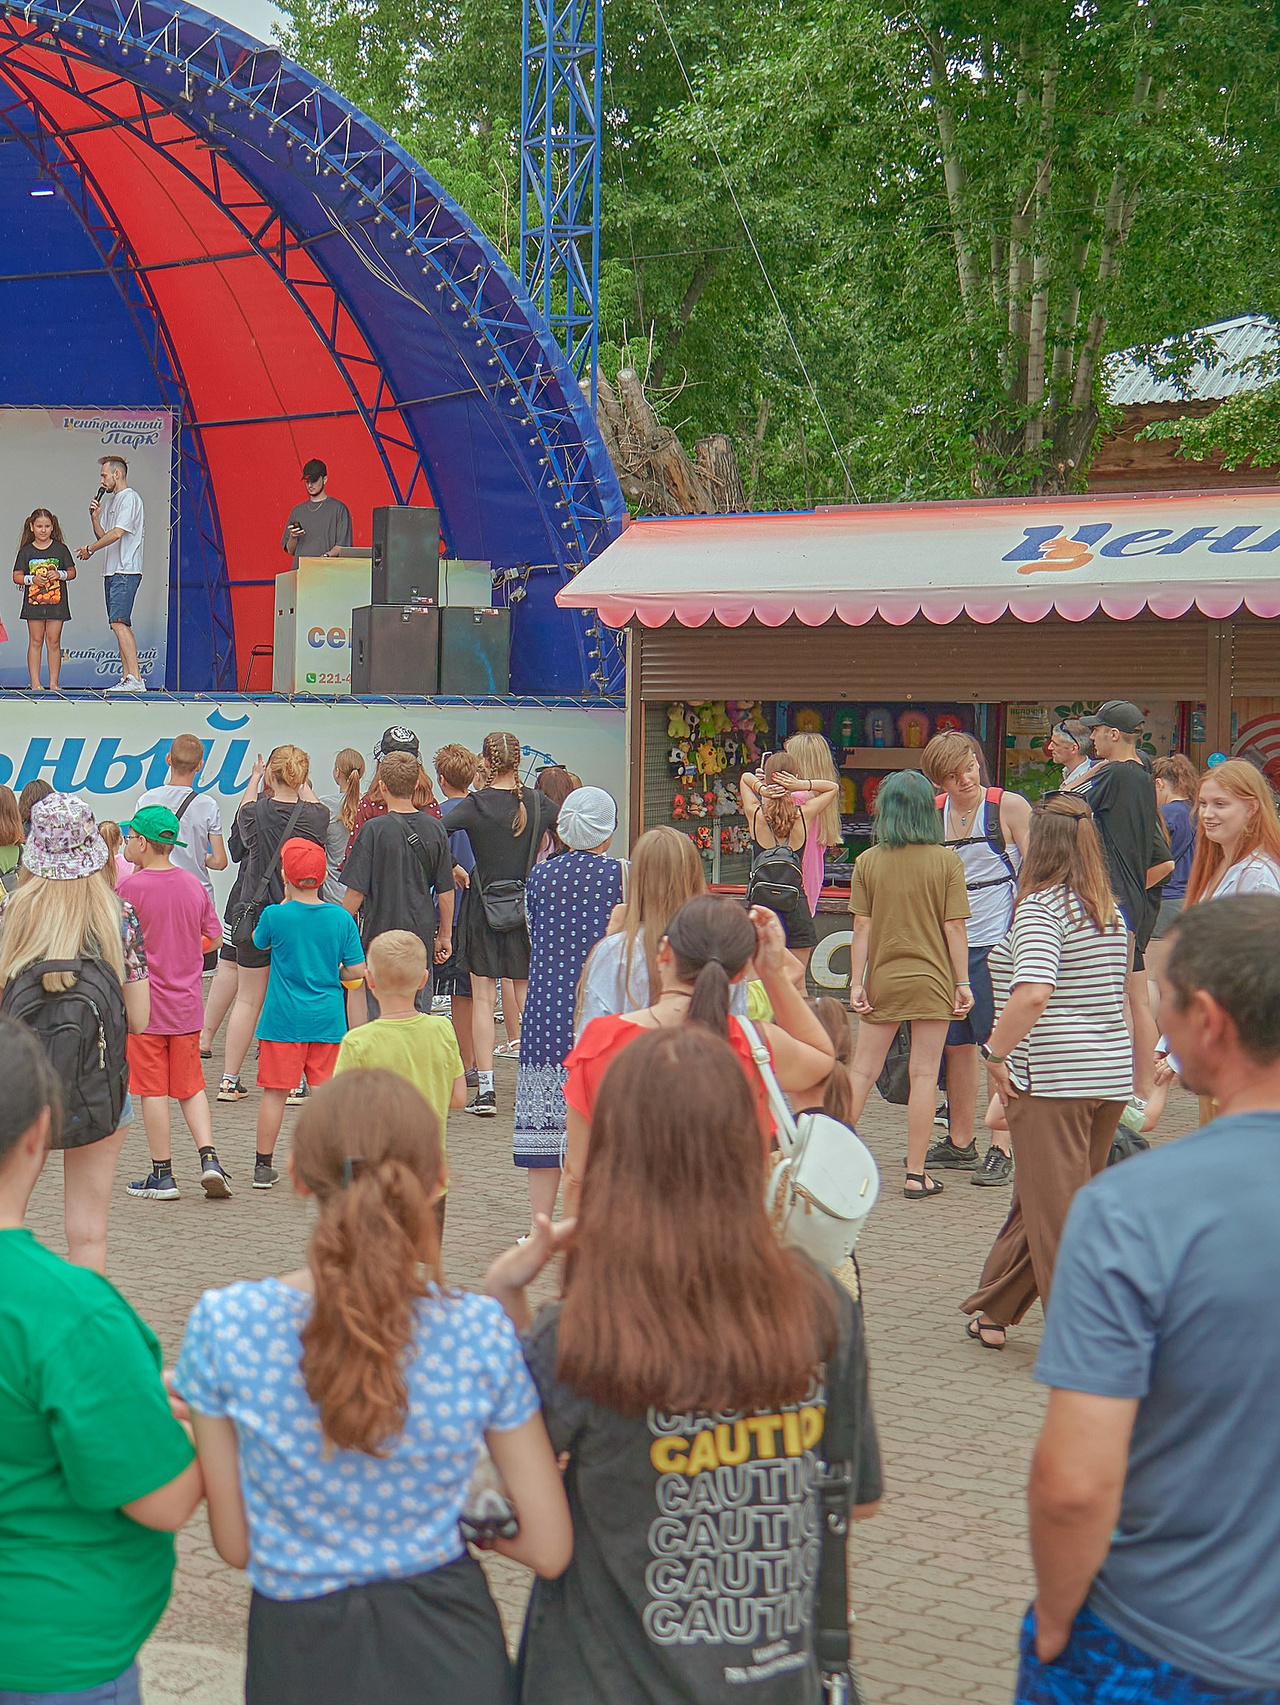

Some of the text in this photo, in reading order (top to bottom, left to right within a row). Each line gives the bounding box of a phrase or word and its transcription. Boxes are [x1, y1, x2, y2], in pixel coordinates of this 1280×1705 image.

[63, 418, 163, 432] Центральный
[101, 430, 159, 450] Парк
[96, 659, 153, 675] Пак
